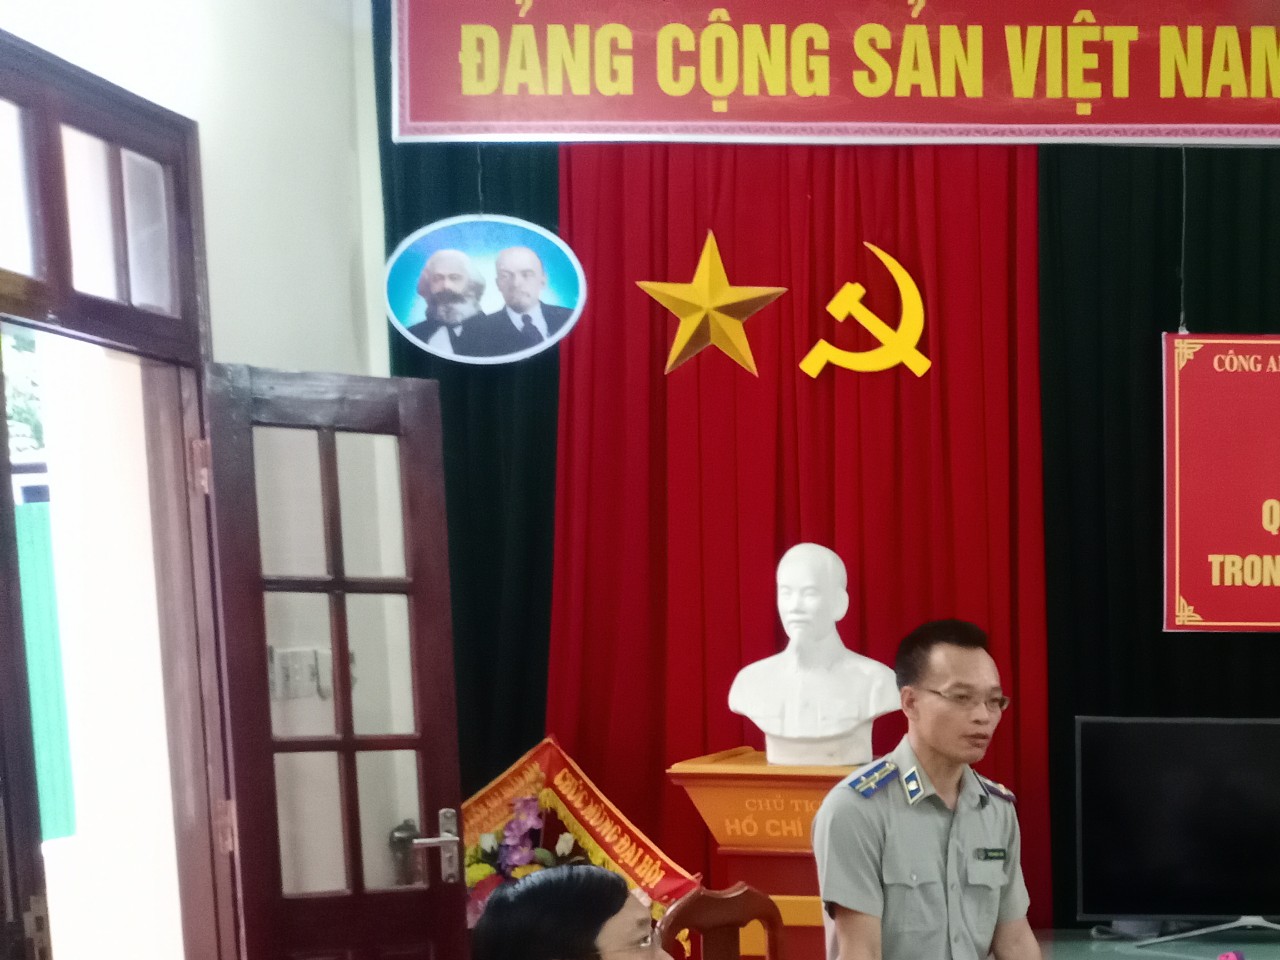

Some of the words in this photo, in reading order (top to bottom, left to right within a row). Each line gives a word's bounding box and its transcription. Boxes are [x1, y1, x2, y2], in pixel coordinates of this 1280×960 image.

[458, 0, 634, 97] ĐẢNG
[656, 8, 830, 112] CỘNG
[853, 0, 984, 99] SẢN
[1004, 9, 1139, 115] VIỆT
[1212, 349, 1263, 373] CÔNG
[765, 816, 804, 837] CHÍ
